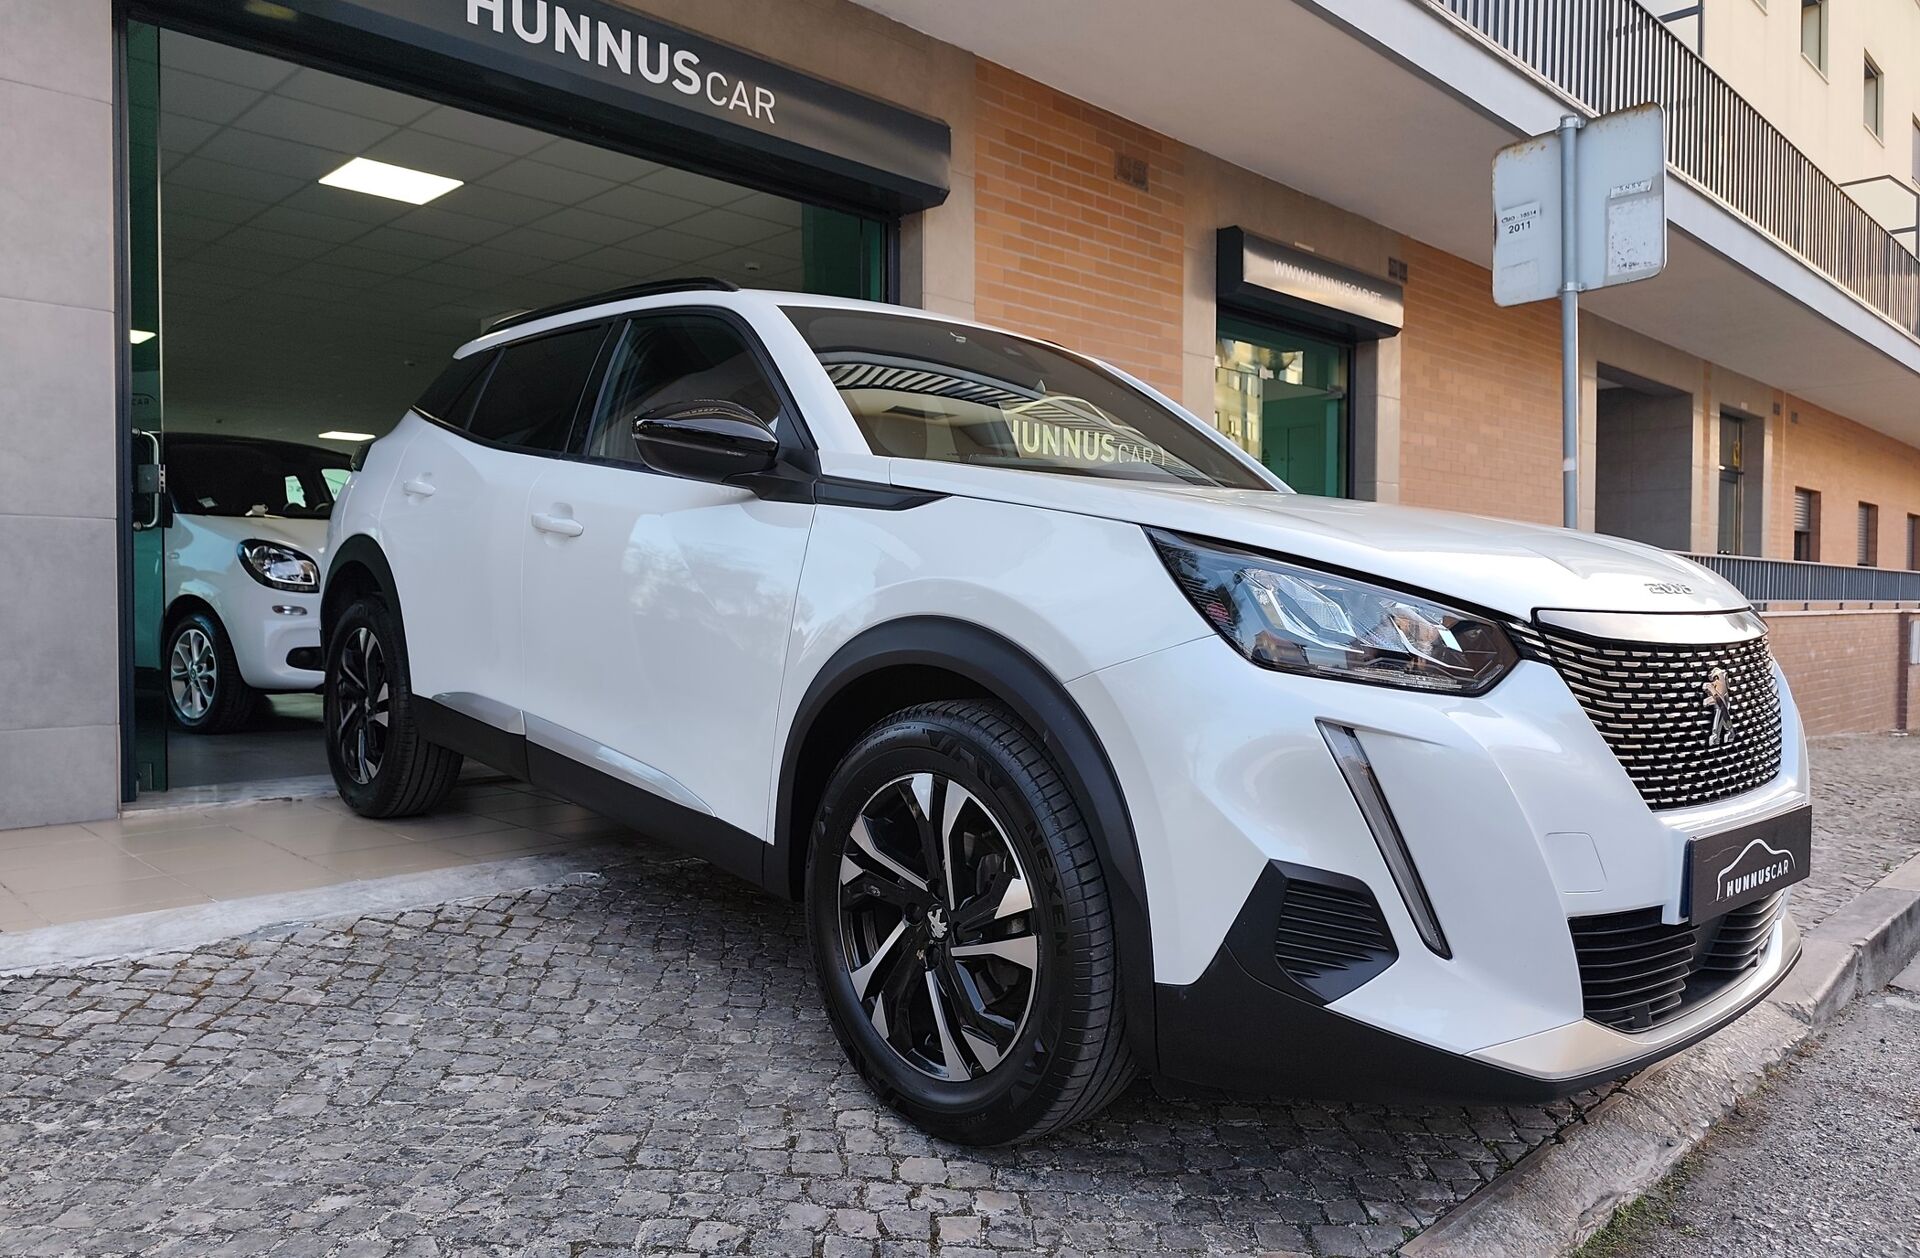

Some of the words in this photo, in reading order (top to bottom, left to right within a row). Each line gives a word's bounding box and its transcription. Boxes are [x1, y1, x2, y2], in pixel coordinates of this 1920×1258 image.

[467, 0, 776, 124] HUNNUSCAR
[1508, 220, 1531, 234] 2011
[1023, 820, 1069, 958] NEXEN
[1726, 859, 1790, 898] HUNNUSCAR
